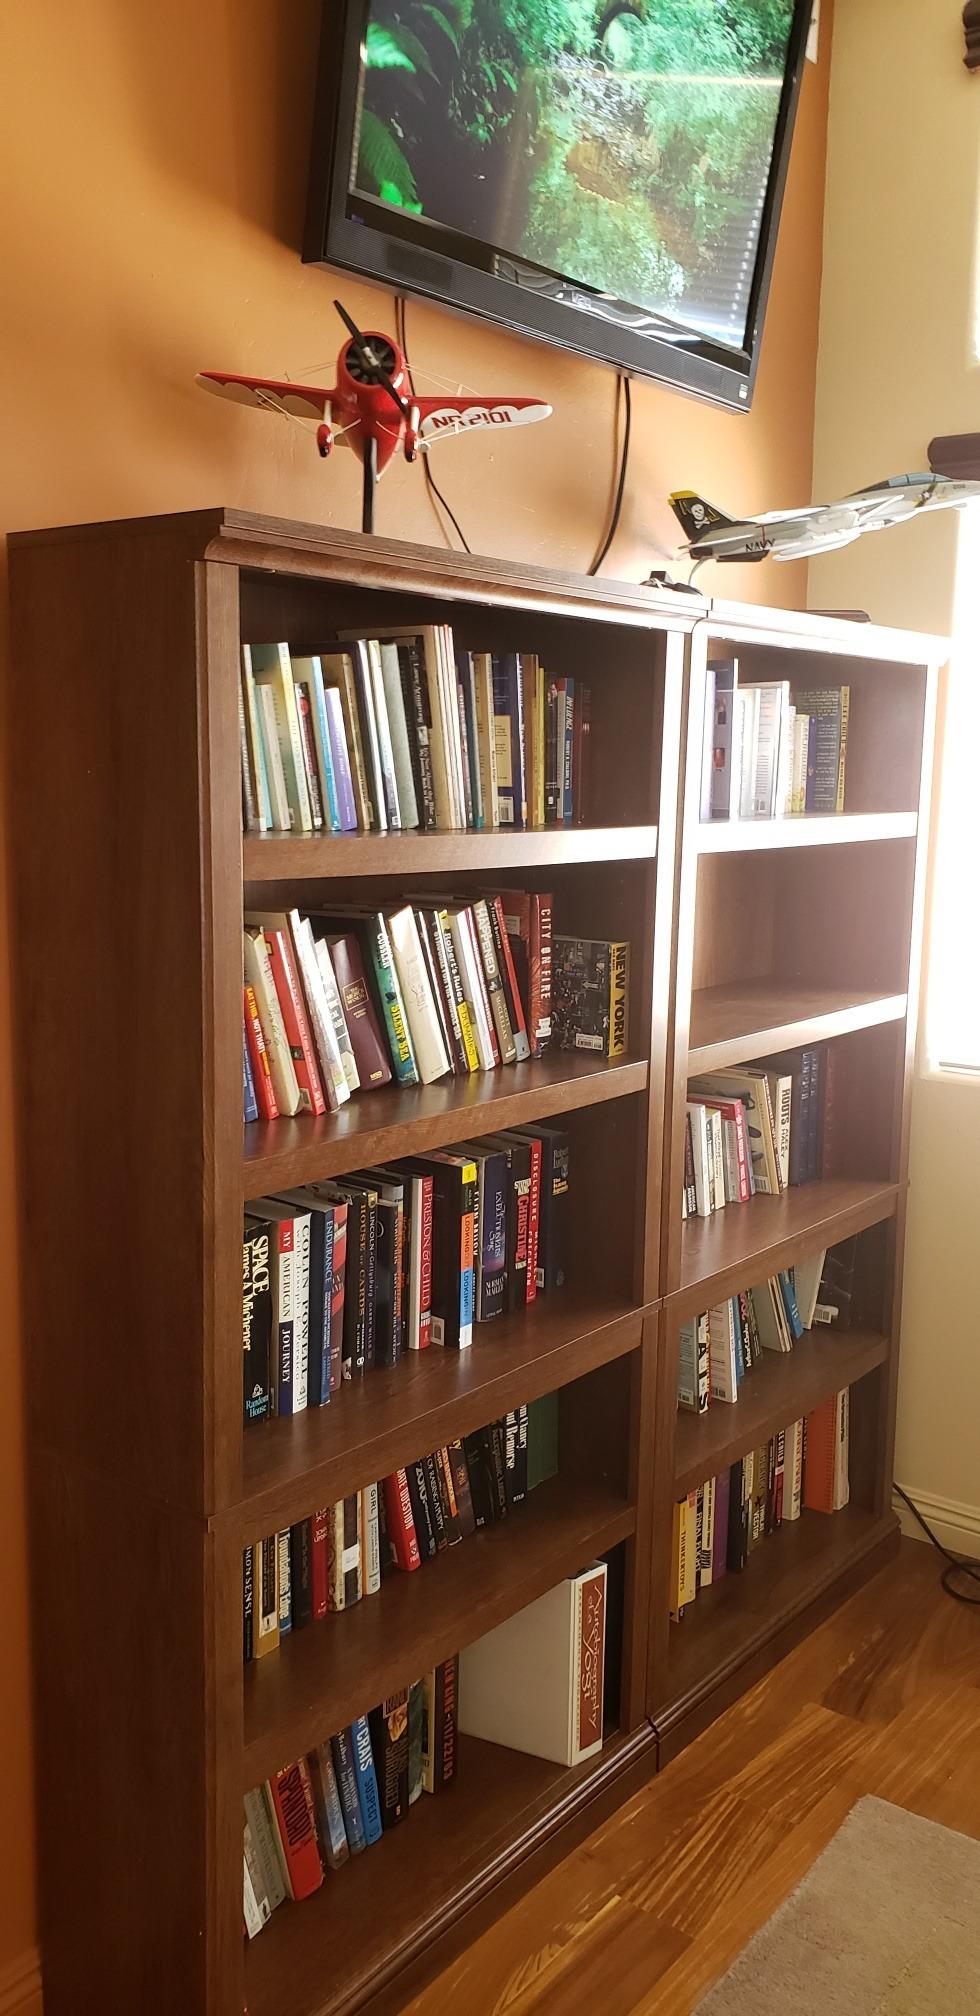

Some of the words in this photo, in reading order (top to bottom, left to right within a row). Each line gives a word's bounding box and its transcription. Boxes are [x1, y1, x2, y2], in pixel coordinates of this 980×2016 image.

[745, 536, 776, 552] NAVY
[413, 686, 425, 723] Armstrong
[565, 696, 574, 730] INFLUENCE
[490, 906, 498, 926] Frank
[540, 907, 552, 938] CITY
[475, 907, 495, 975] HAPPENED
[540, 946, 552, 965] ON
[444, 932, 458, 974] Robert's
[453, 975, 464, 1003] Rules
[540, 970, 552, 1000] FIRE
[614, 946, 627, 990] NEW
[252, 1018, 262, 1033] NOT
[390, 1004, 405, 1039] SILENT
[613, 993, 626, 1047] YORK
[397, 1041, 410, 1062] SEA
[781, 1087, 791, 1126] ROOTS
[531, 1153, 539, 1222] DISCLOSURE
[283, 1230, 291, 1248] MY
[516, 1194, 530, 1262] CHRISTINE
[252, 1234, 270, 1296] SPACE
[302, 1224, 310, 1289] COLIN
[325, 1220, 334, 1284] ENDURANCE
[422, 1249, 431, 1261] &
[282, 1255, 291, 1318] AMERICAN
[421, 1262, 431, 1306] CHILD
[243, 1294, 254, 1351] Michener
[301, 1300, 310, 1380] POWELL
[282, 1328, 292, 1383] JOURNEY
[246, 1393, 269, 1411] Random
[249, 1404, 267, 1418] House
[506, 1424, 518, 1469] Remorse
[516, 1416, 529, 1449] Clancy
[777, 1440, 785, 1462] CHILD
[399, 1488, 414, 1530] QUESTION
[695, 1511, 703, 1537] FINAL
[679, 1530, 687, 1593] THINKERTOYS
[279, 1594, 291, 1620] Edge
[581, 1638, 595, 1701] Yogi
[589, 1585, 603, 1729] Autobiography
[357, 1728, 372, 1771] CRAIS
[385, 1746, 399, 1808] SHRUGGED
[364, 1780, 378, 1823] SUSPECT
